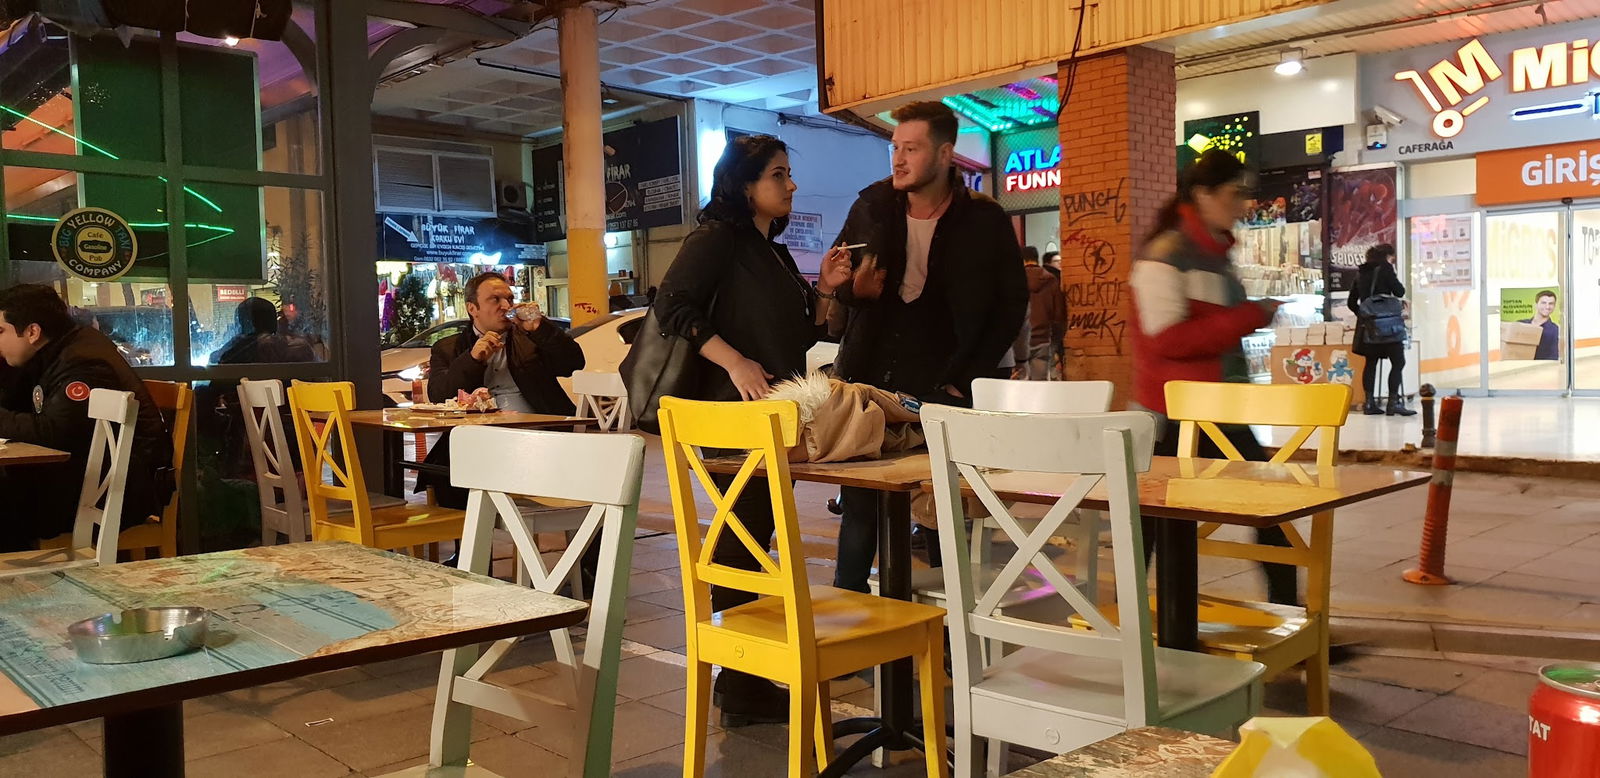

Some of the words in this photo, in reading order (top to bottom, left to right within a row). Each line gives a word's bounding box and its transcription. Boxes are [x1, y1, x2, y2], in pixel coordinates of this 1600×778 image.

[60, 228, 72, 248] BIG
[67, 213, 116, 230] YELLOW
[68, 258, 122, 276] COMPANY
